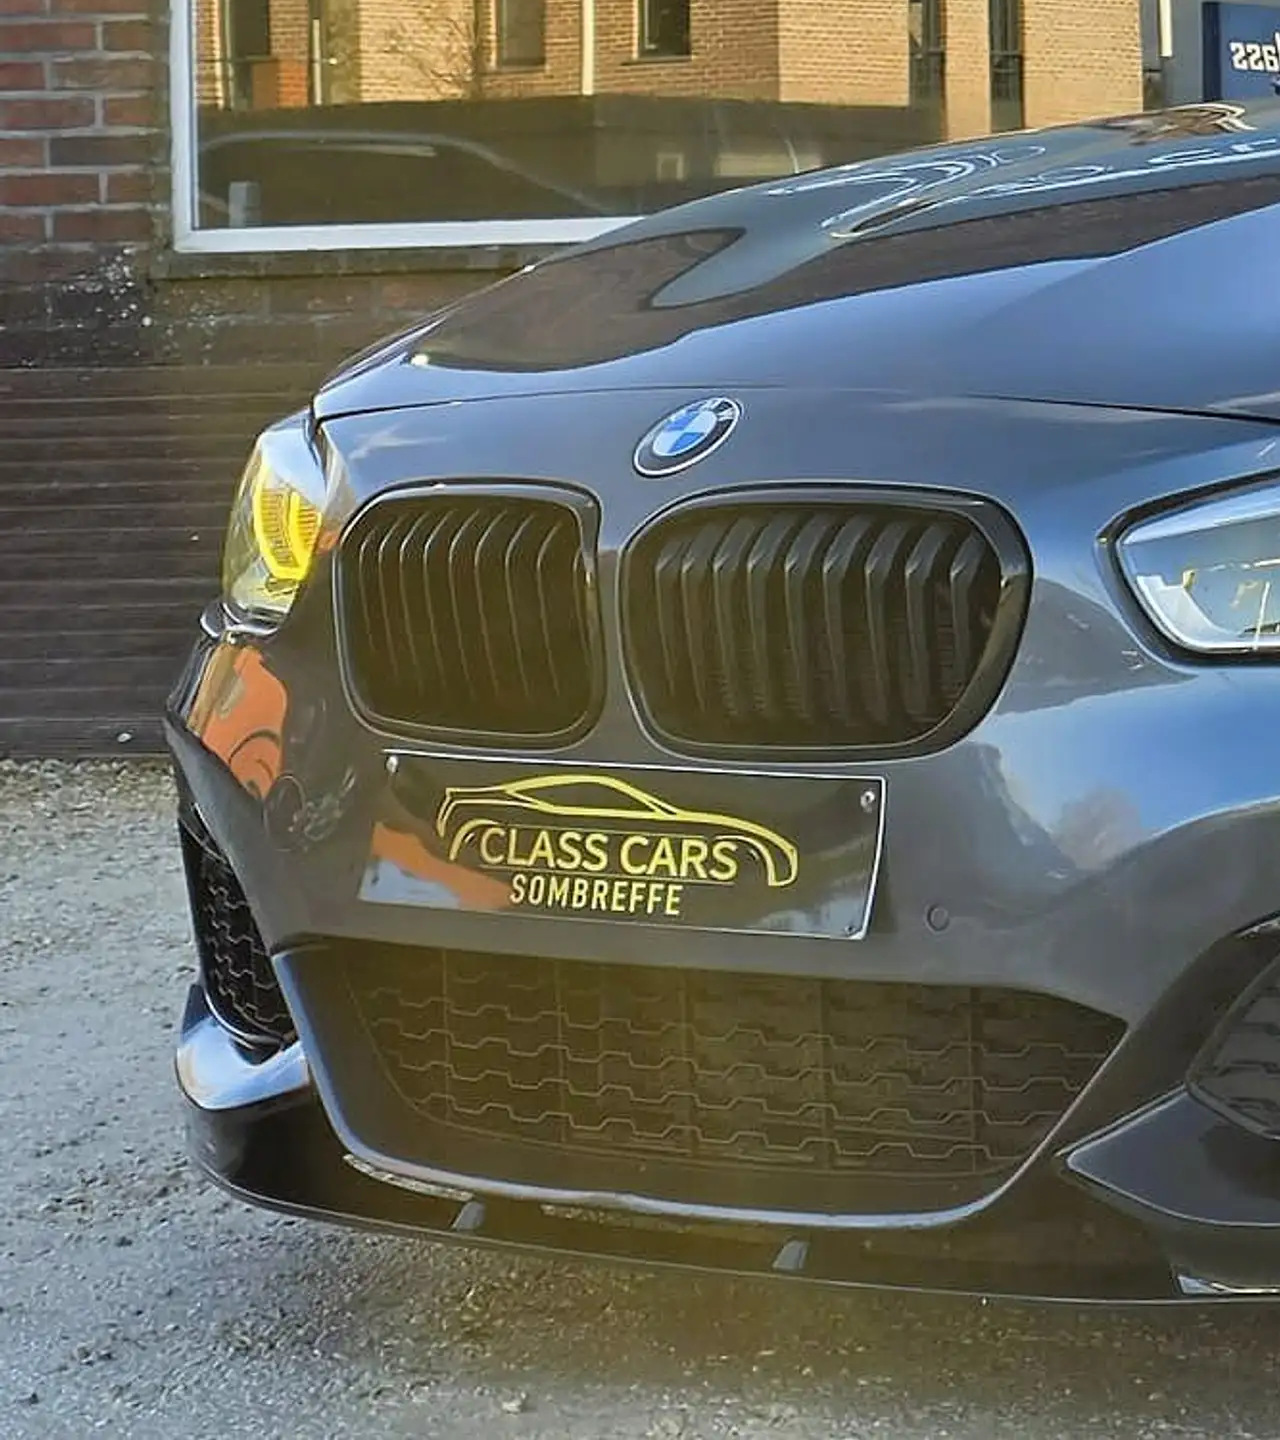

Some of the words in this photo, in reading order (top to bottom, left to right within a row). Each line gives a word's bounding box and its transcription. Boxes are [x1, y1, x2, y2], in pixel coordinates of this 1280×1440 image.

[480, 827, 609, 871] CLASS
[620, 835, 738, 880] CARS
[510, 874, 684, 916] SOMBREFFE
